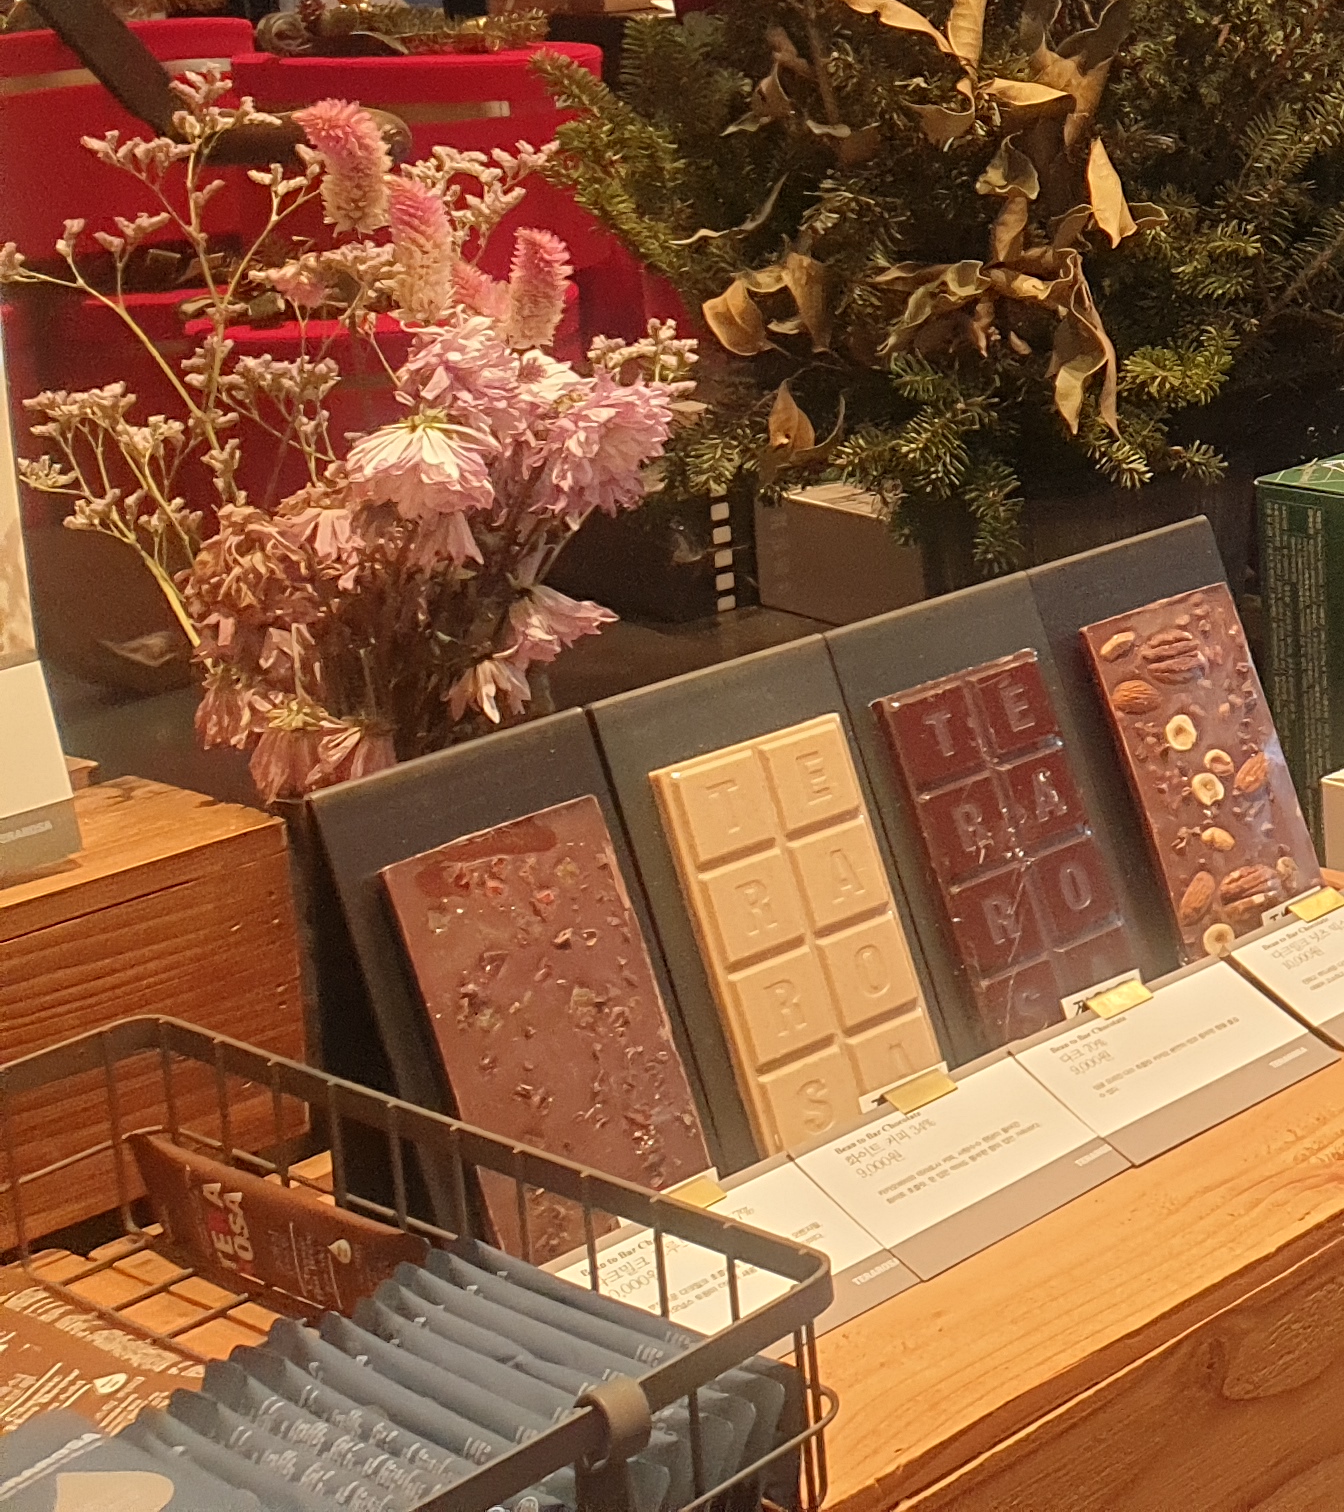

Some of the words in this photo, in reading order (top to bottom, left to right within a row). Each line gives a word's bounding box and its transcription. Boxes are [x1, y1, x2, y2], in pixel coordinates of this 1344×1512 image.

[1069, 1049, 1115, 1076] 9,000원
[834, 1141, 856, 1155] Bean
[856, 1137, 867, 1145] to
[866, 1127, 881, 1140] Bar
[881, 1111, 922, 1133] Chocolate
[845, 1142, 887, 1167] 화이트
[909, 1117, 937, 1136] 34%
[855, 1149, 906, 1179] 9,000원
